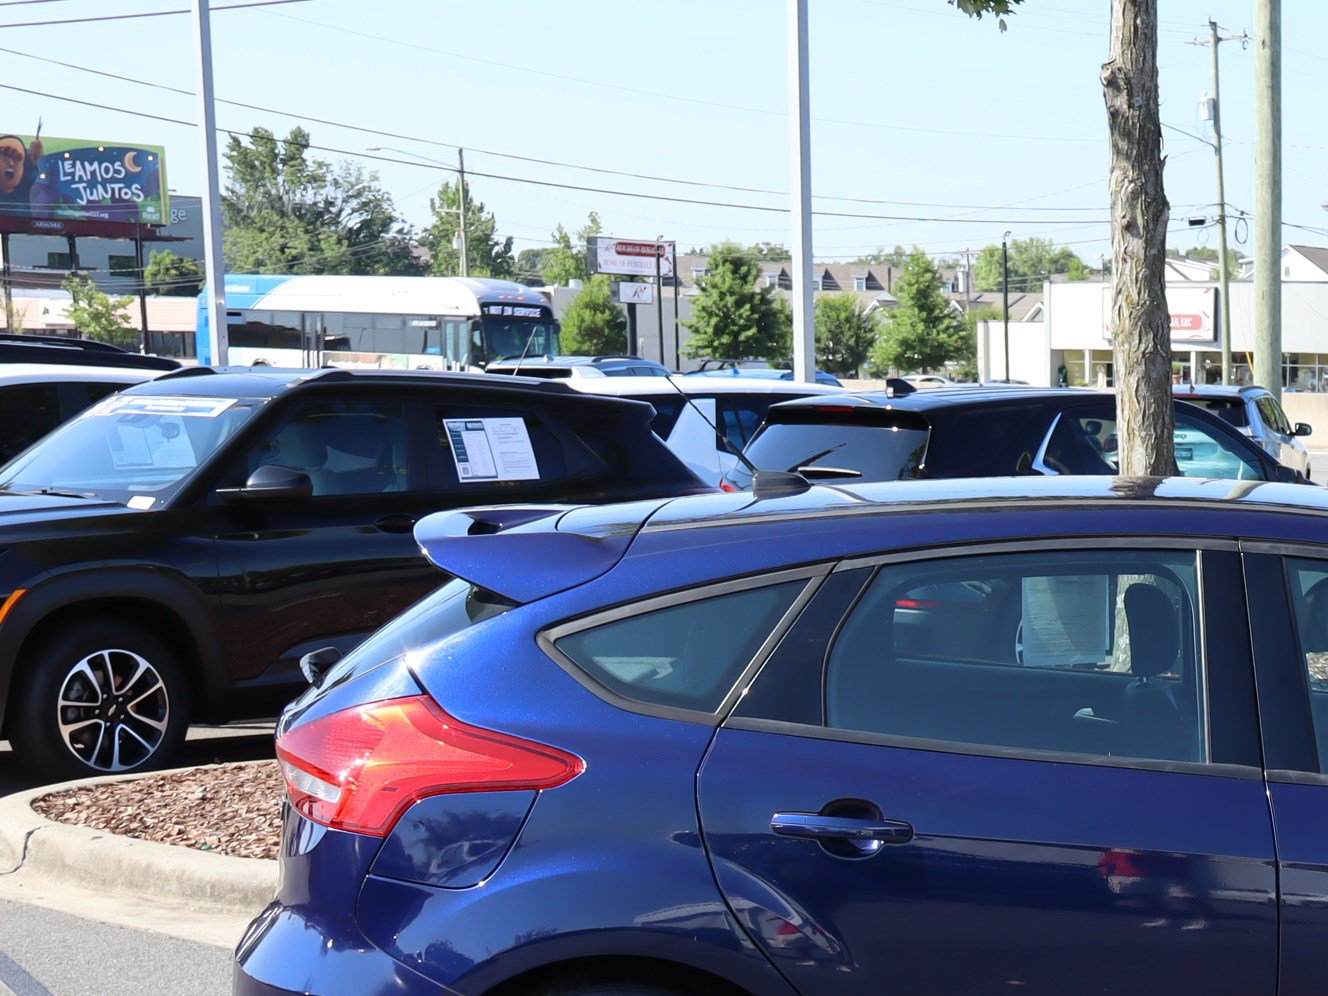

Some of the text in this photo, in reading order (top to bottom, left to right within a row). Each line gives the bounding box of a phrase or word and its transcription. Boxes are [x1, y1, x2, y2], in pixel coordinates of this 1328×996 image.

[57, 159, 126, 182] LEAMOS
[71, 183, 144, 205] JUNTOS
[513, 306, 541, 318] SERVICE
